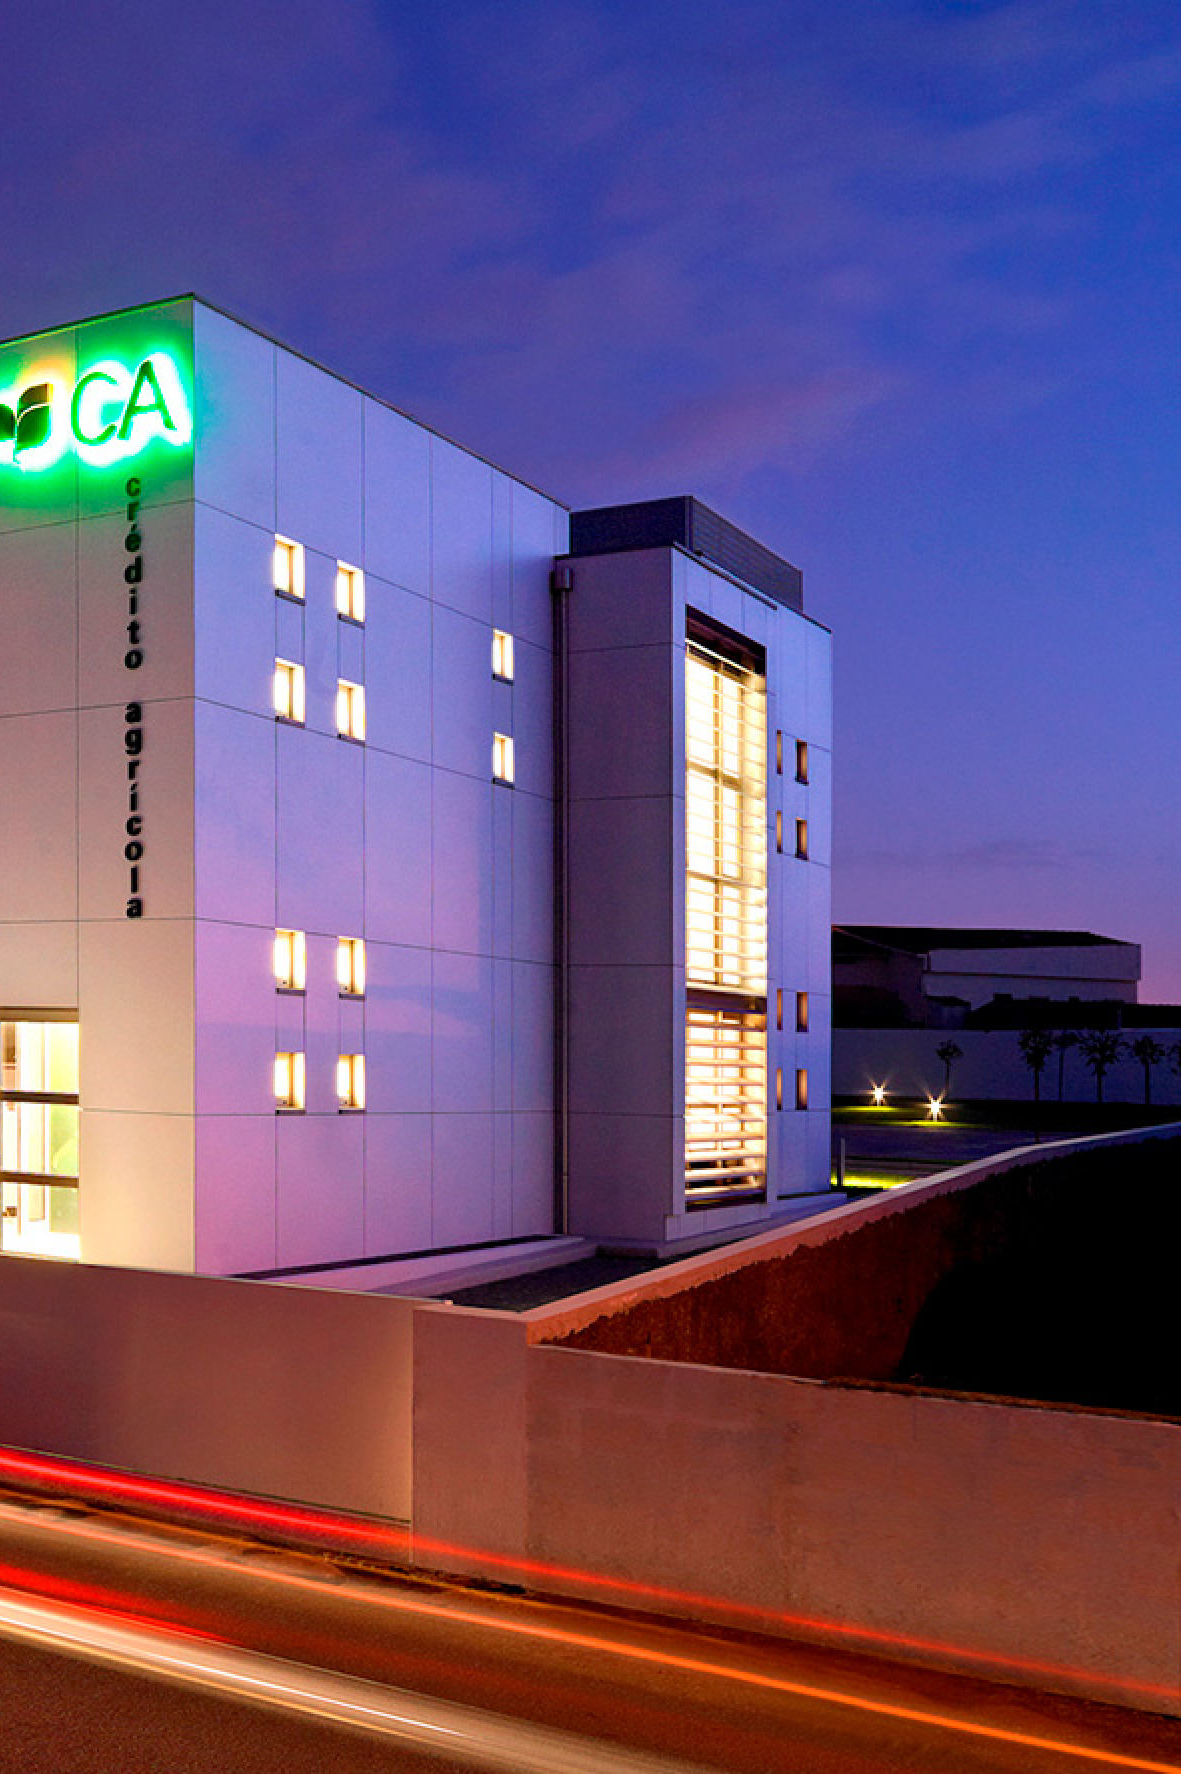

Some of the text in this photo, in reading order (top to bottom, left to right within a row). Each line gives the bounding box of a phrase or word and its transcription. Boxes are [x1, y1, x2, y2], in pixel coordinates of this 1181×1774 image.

[71, 360, 176, 446] CA
[124, 477, 144, 918] crédito agrícola
